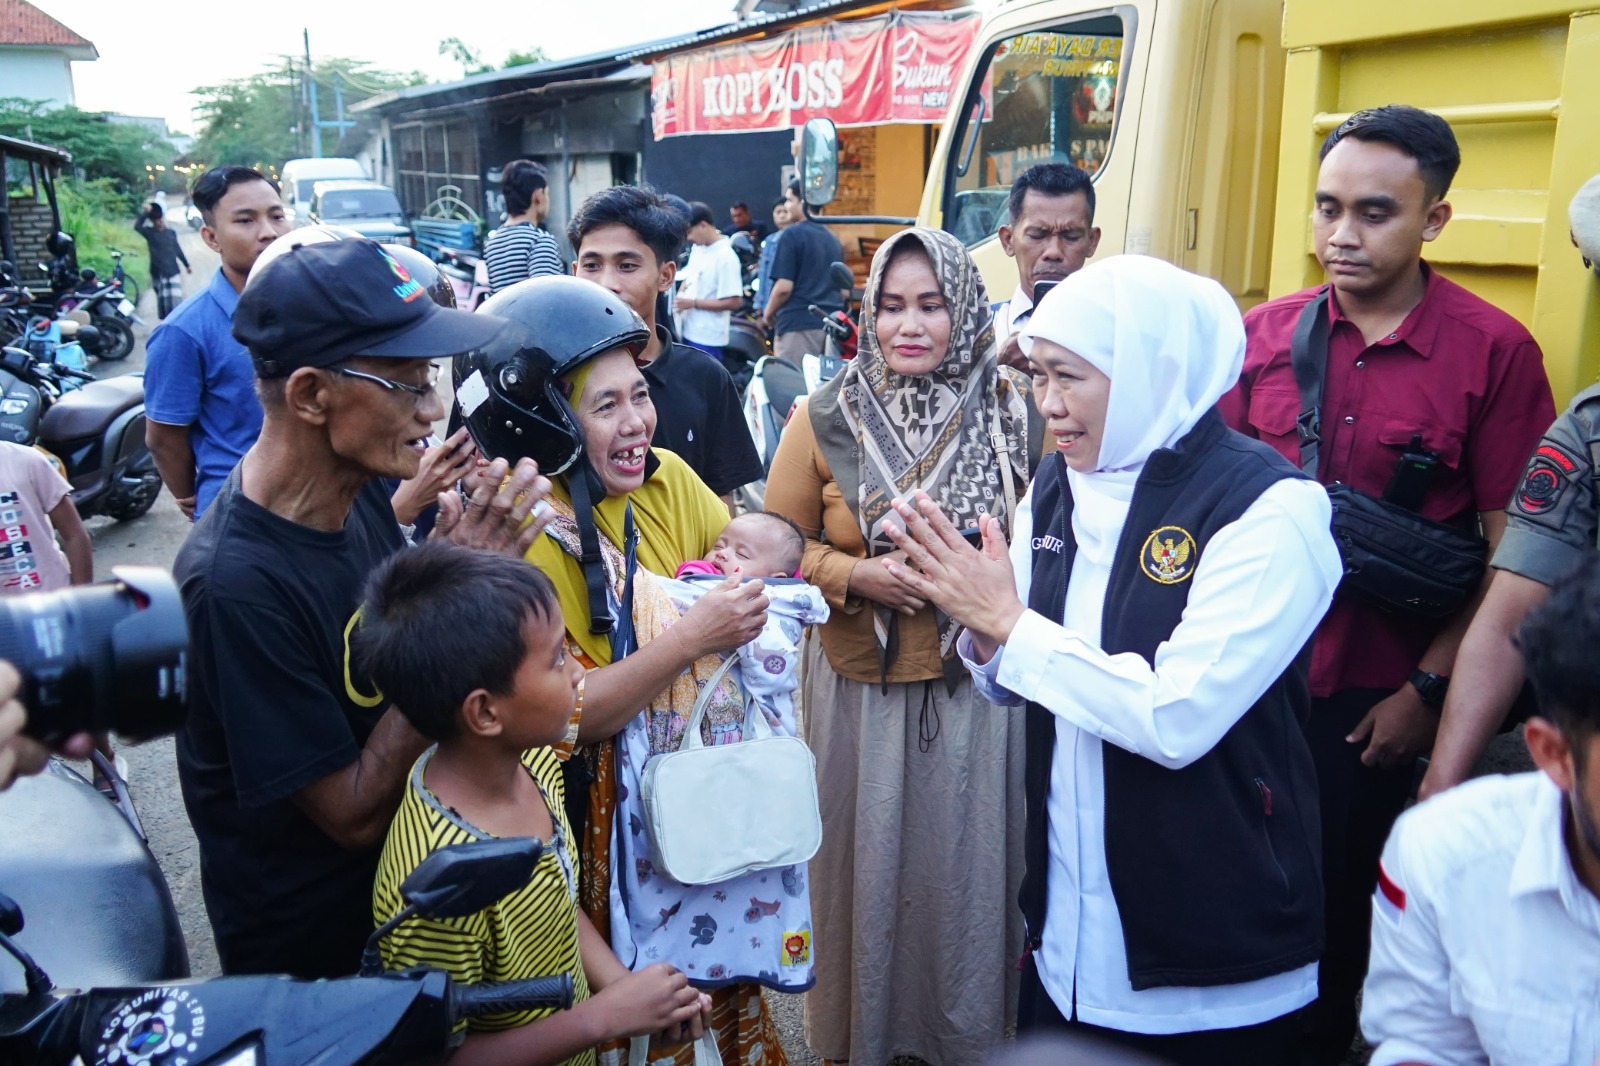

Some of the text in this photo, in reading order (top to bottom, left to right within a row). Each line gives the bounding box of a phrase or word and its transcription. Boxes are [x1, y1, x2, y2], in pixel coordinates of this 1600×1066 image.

[702, 73, 763, 117] KOPI
[769, 58, 844, 112] BOSS
[922, 91, 948, 108] NEW
[102, 987, 190, 1039] KOMUNITAS
